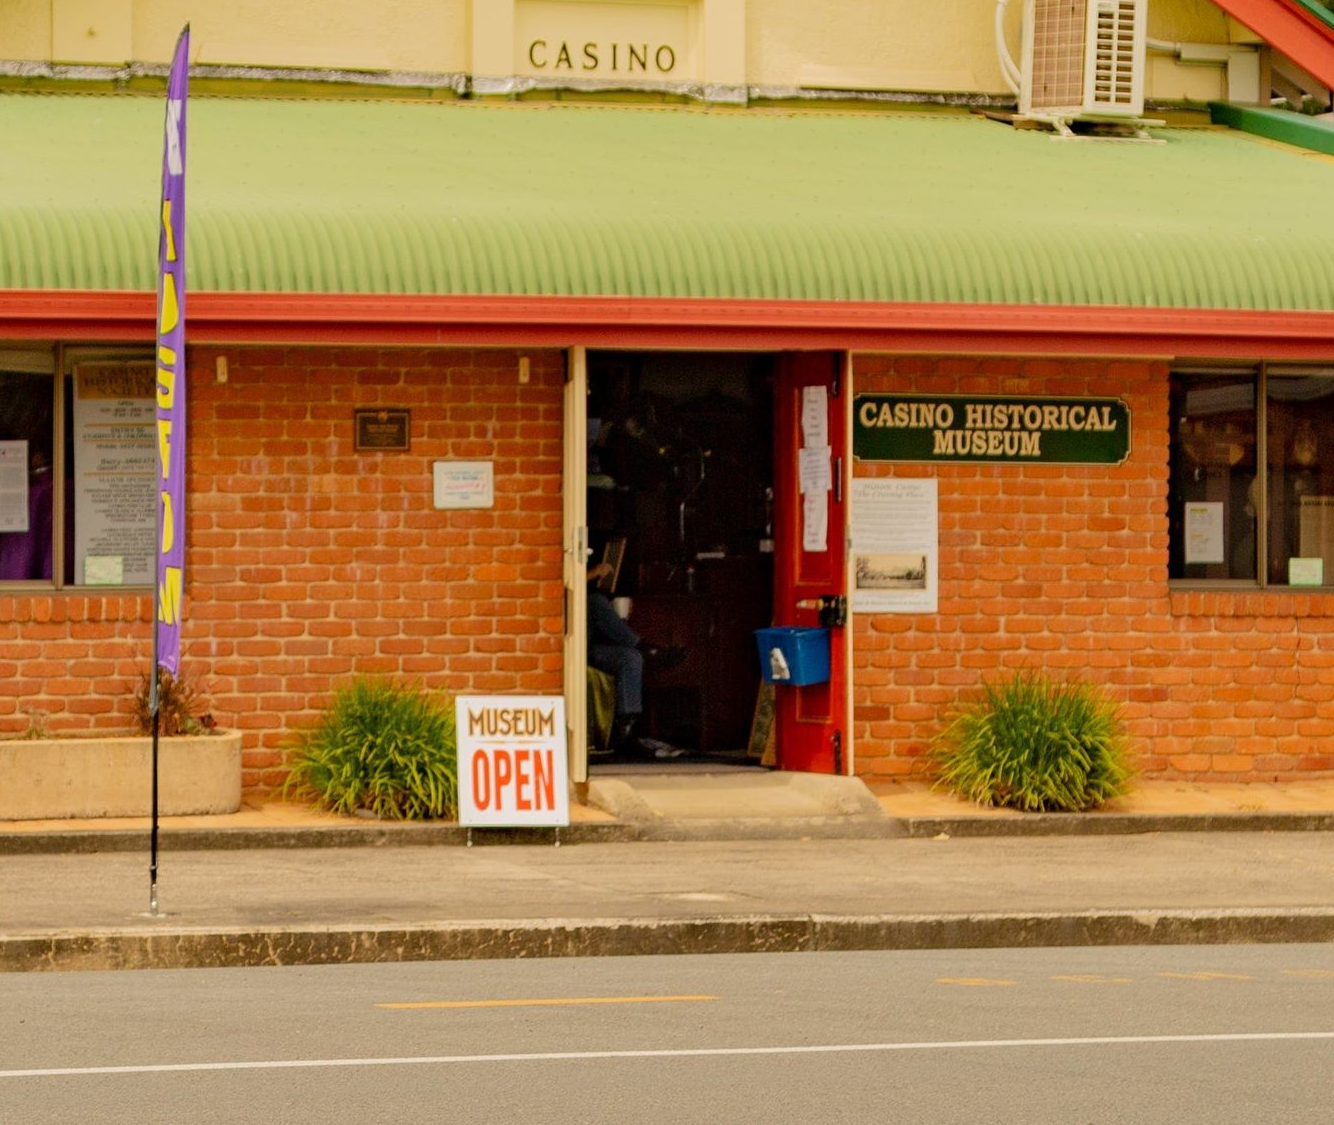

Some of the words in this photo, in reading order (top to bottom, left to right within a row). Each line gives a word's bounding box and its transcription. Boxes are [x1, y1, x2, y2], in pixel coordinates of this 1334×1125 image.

[528, 40, 676, 72] CASINO
[859, 402, 954, 428] CASINO
[965, 404, 1116, 431] HISTORICAL
[933, 430, 1042, 456] MUSEUM
[468, 707, 555, 737] MUSEUM
[471, 748, 555, 812] OPEN
